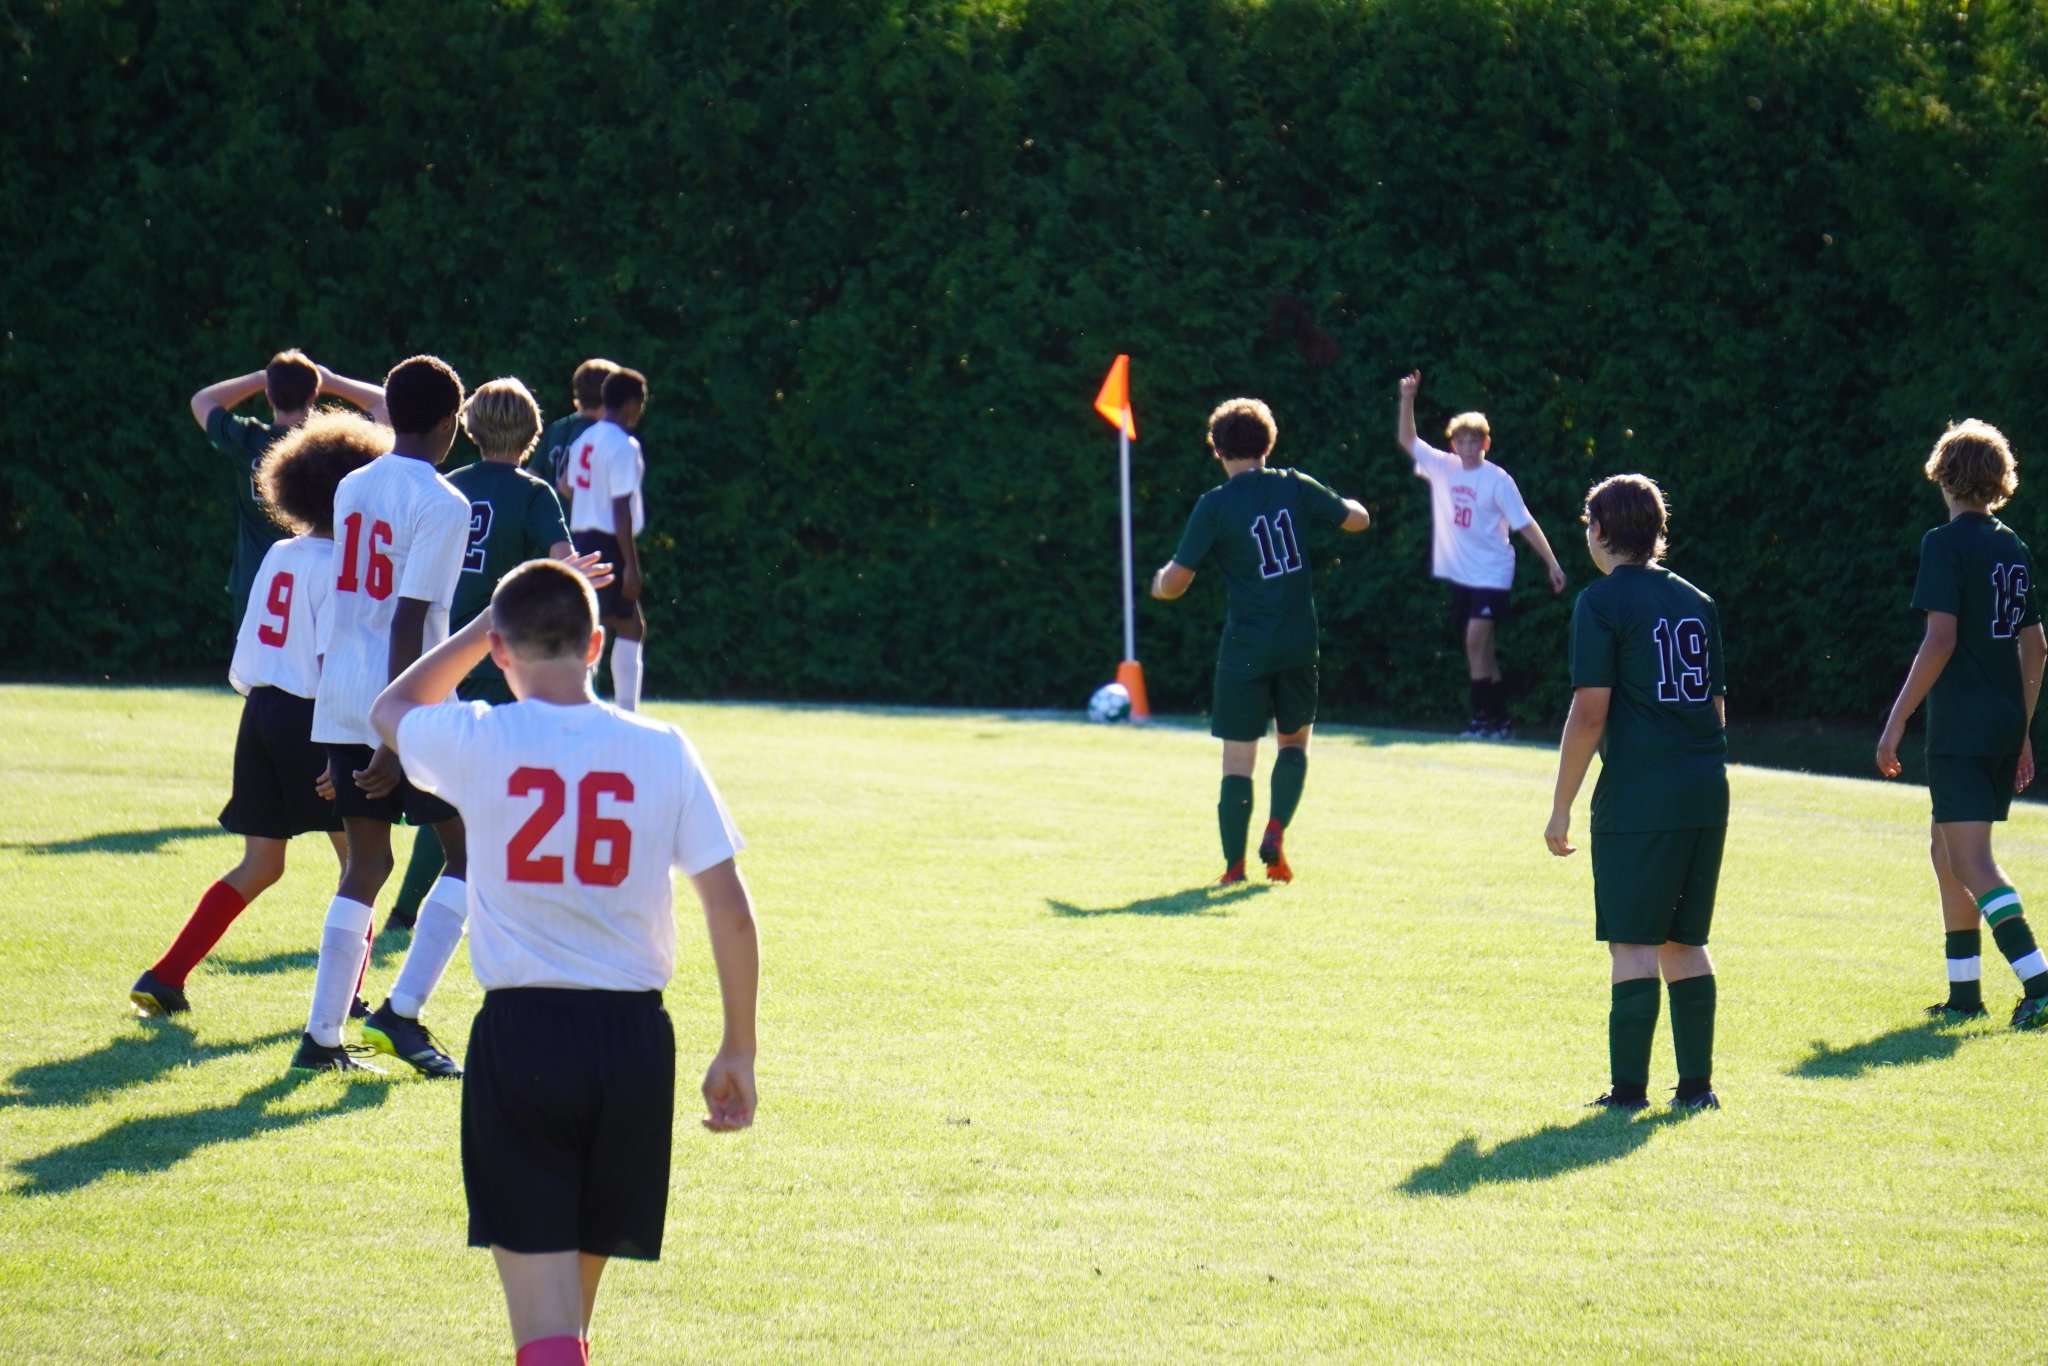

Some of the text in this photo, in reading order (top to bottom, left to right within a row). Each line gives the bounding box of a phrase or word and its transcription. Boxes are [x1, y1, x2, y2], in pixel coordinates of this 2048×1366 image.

[576, 444, 593, 489] 5
[1251, 508, 1302, 579] 11
[1453, 505, 1472, 528] 20
[336, 512, 393, 601] 16
[258, 571, 294, 648] 9
[1992, 563, 2029, 638] 16
[1653, 618, 1711, 701] 19
[507, 766, 635, 888] 26
